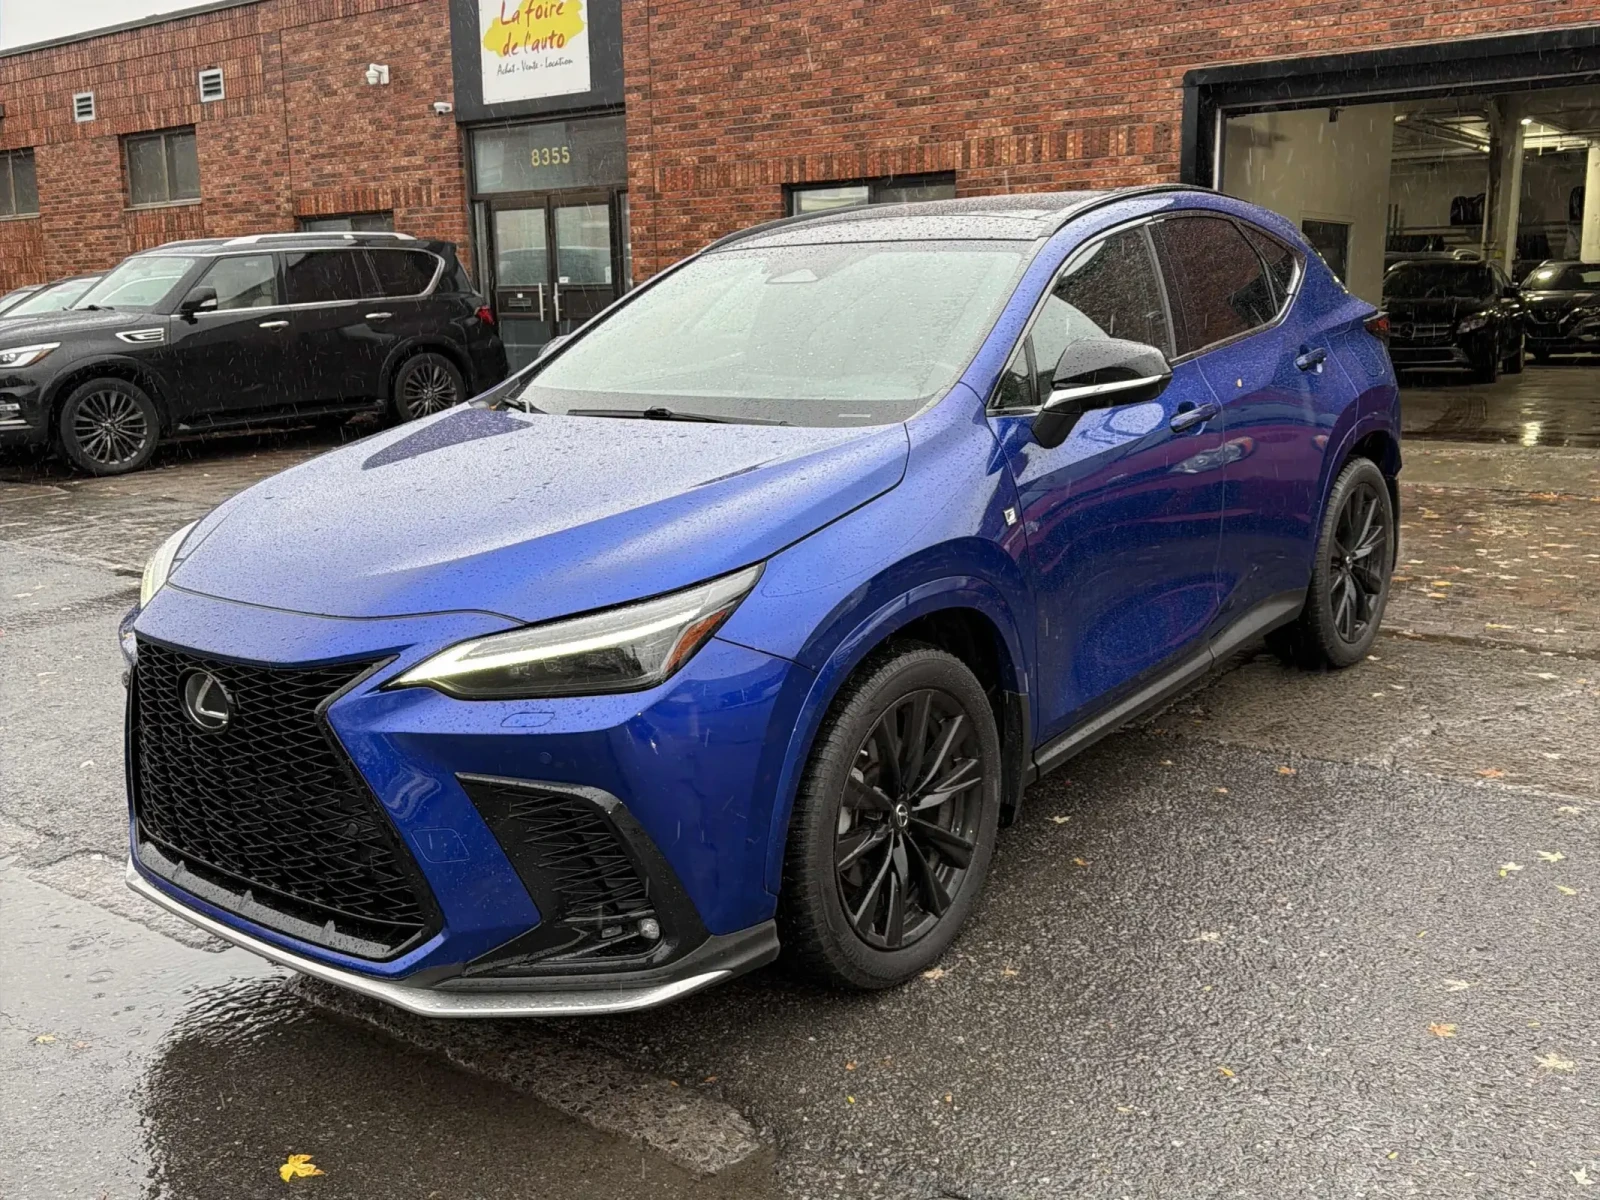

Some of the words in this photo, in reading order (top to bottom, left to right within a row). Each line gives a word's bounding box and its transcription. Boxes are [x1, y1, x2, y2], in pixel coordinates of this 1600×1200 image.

[501, 0, 520, 25] La
[525, 0, 564, 27] foire
[502, 32, 519, 57] de
[523, 30, 565, 54] l'auto
[497, 62, 516, 76] Achat
[521, 60, 539, 72] Vente
[545, 57, 573, 69] Location
[531, 146, 570, 167] 8355
